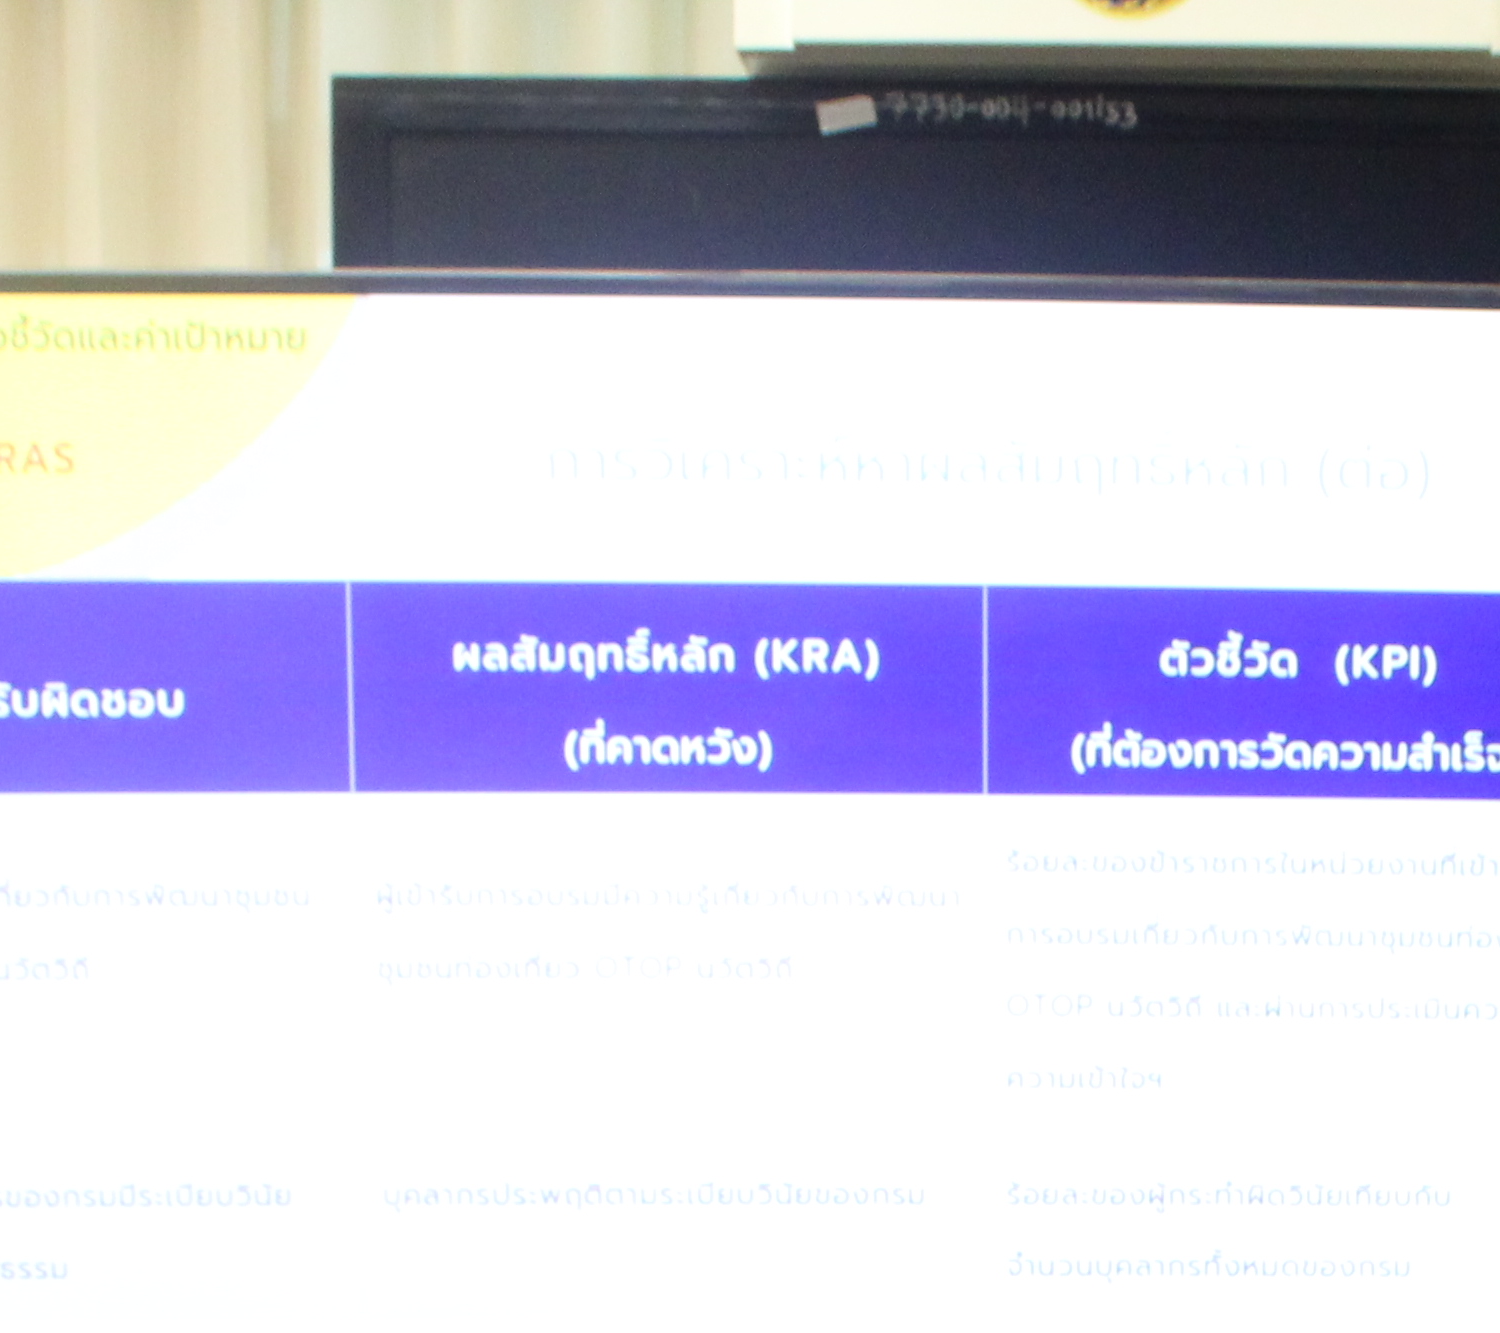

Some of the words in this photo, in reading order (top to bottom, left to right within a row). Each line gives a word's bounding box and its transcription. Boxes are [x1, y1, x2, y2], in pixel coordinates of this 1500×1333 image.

[1316, 440, 1432, 499] (ต่อ)
[451, 627, 737, 678] ผลสัมฤทธิ์หลัก
[754, 636, 882, 681] (KRA)
[1157, 630, 1299, 682] ตัวชี้วัด
[1334, 642, 1438, 687] (KPI)
[562, 721, 775, 772] (ที่คาดหวัง)
